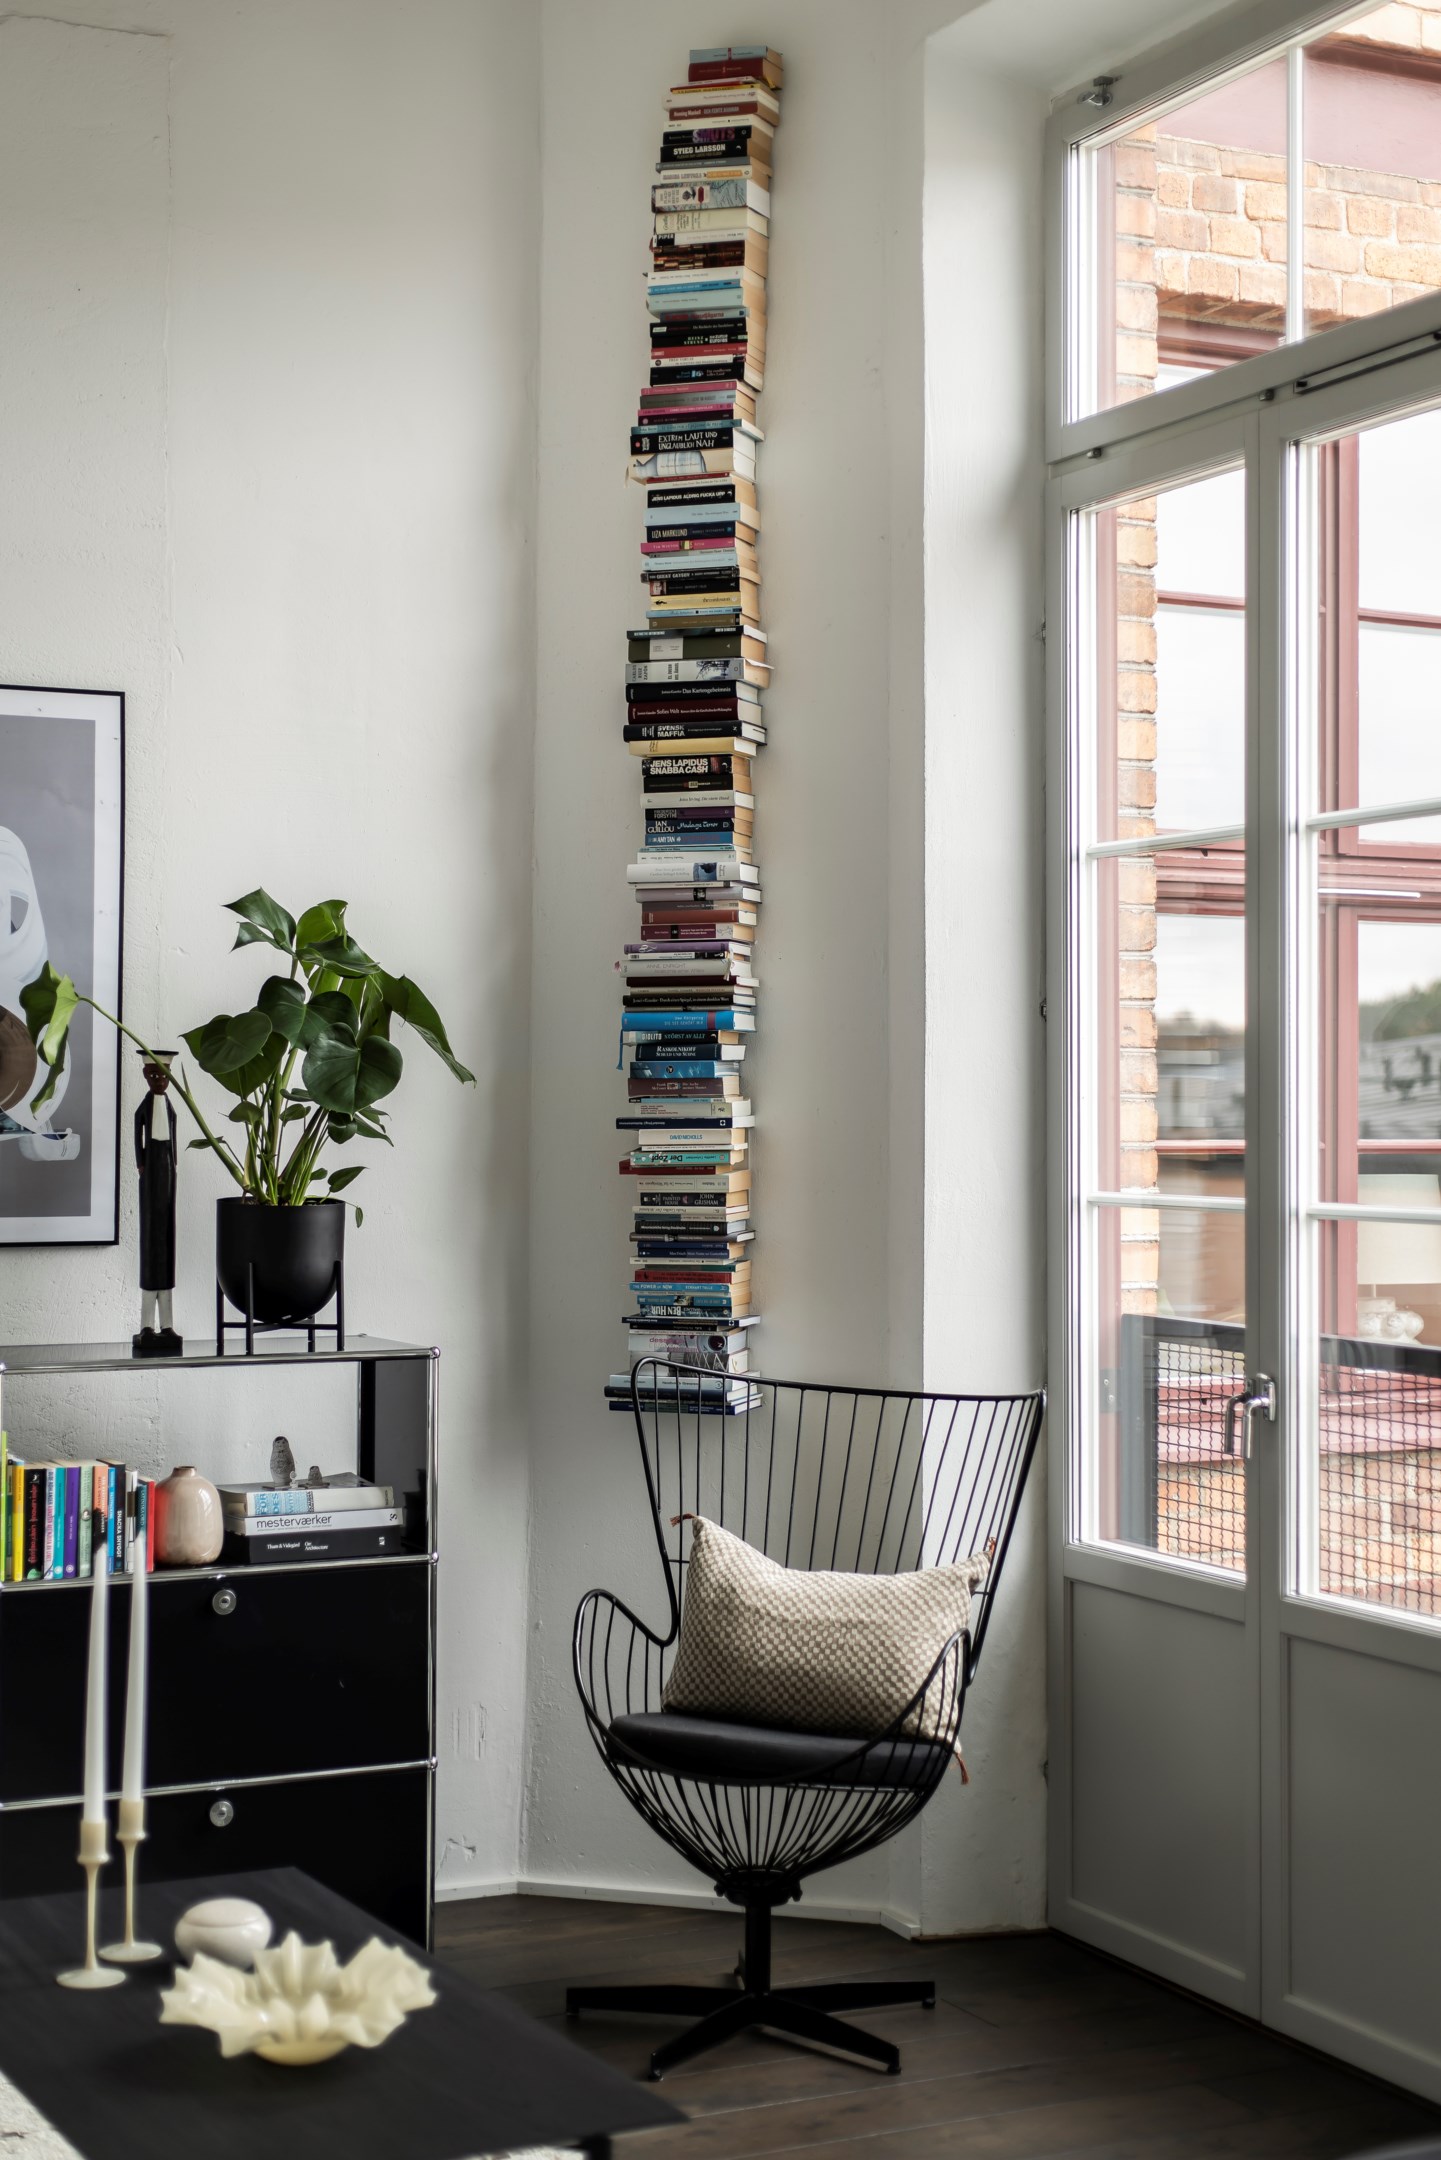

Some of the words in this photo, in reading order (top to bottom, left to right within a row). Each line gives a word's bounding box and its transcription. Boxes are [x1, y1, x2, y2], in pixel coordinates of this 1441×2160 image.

[673, 147, 694, 156] STIEG
[694, 144, 726, 154] LARSSON
[684, 432, 703, 441] LAUT
[705, 431, 718, 439] UND
[695, 439, 714, 448] NAH
[650, 760, 672, 768] JENS
[672, 758, 708, 767] LAPIDUS
[650, 767, 685, 775] SNABBA
[685, 766, 708, 774] CASH
[655, 820, 668, 828] JAN
[651, 1154, 668, 1163] Zopf
[651, 1305, 667, 1316] HUR
[667, 1305, 682, 1316] BEN
[256, 1515, 332, 1528] mesterværker
